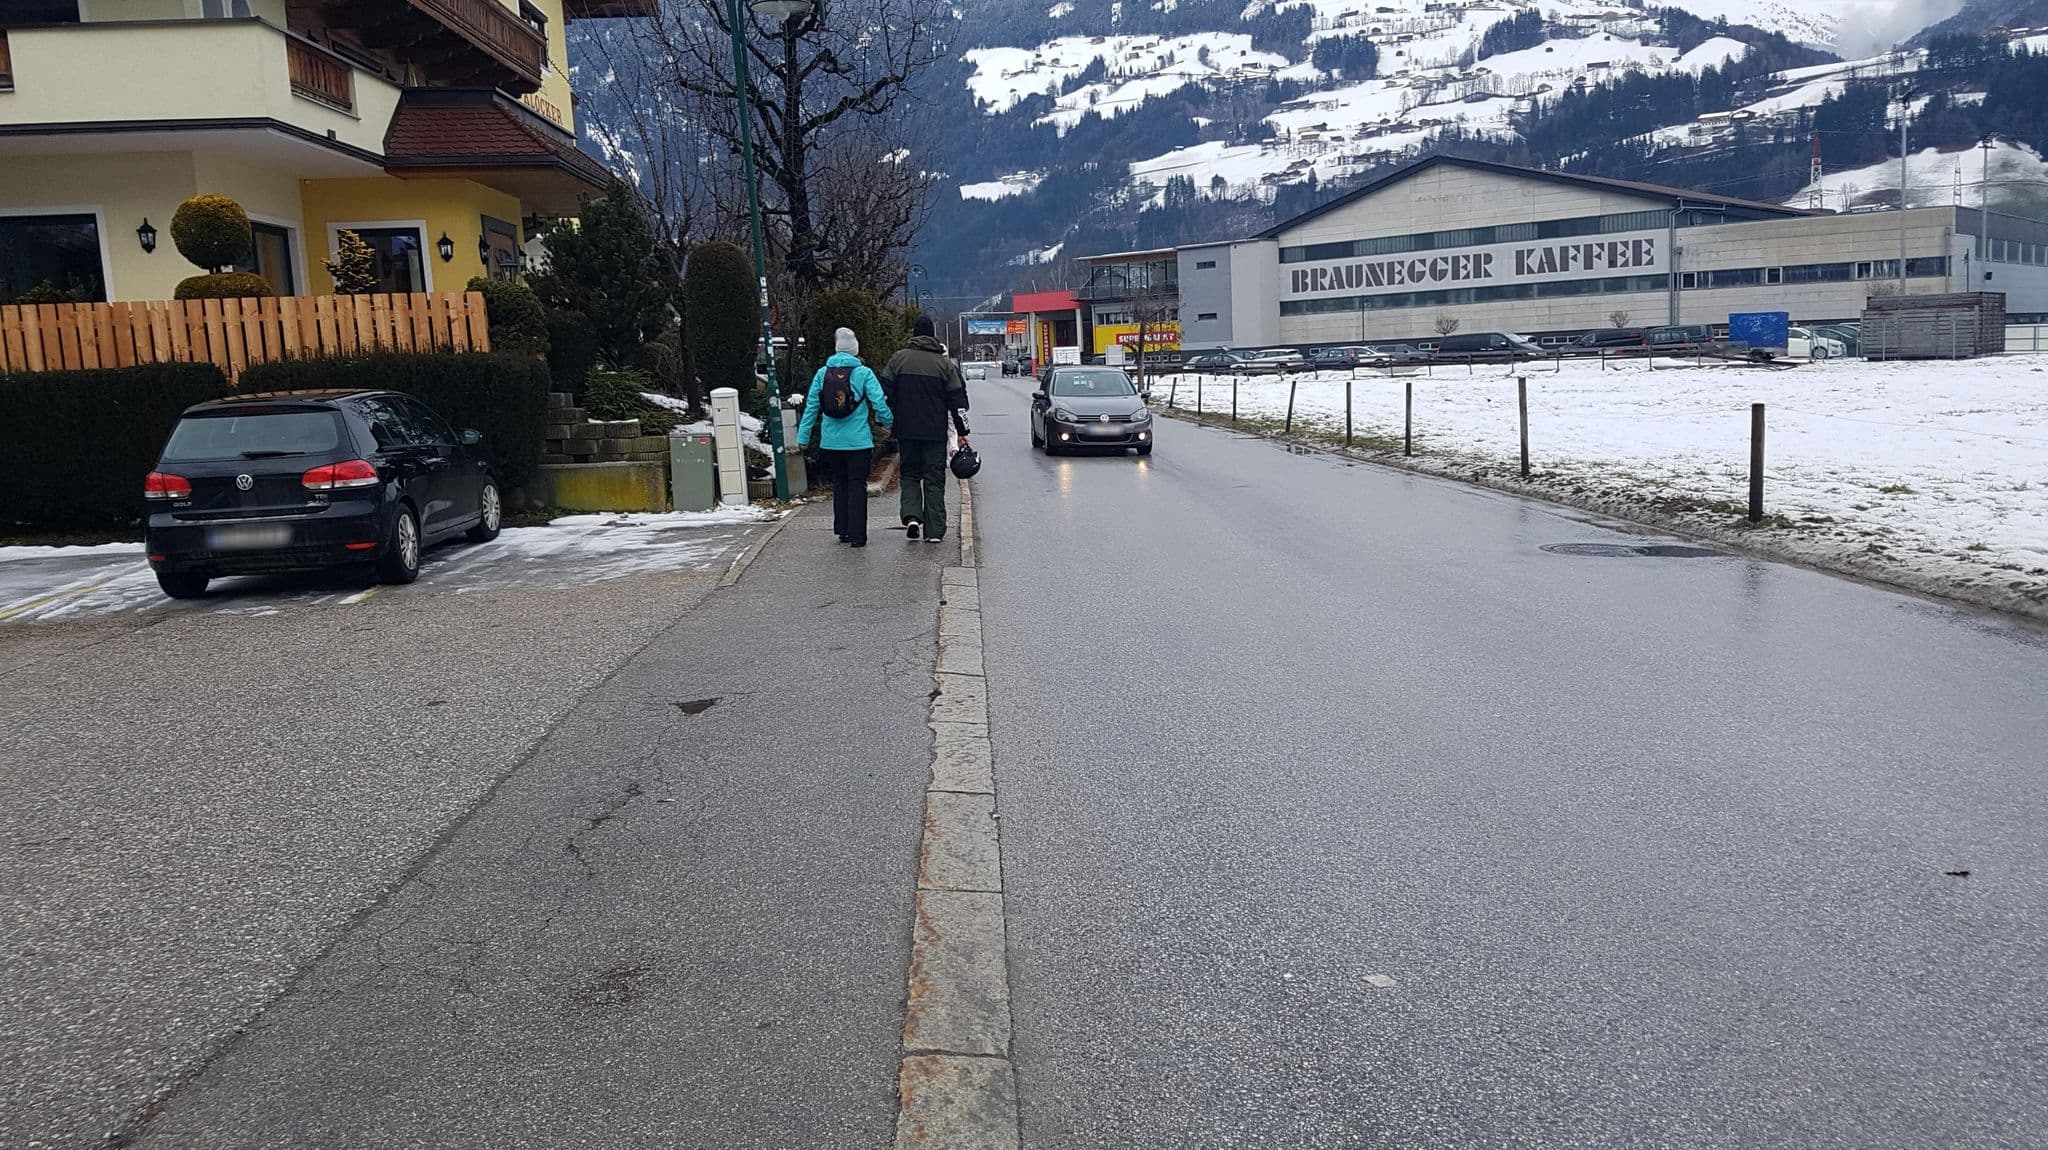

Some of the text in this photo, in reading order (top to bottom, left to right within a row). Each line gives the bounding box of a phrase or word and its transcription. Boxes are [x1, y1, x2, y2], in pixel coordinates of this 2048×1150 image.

[1291, 238, 1655, 293] BRAUNEGGER KAFFEE
[1118, 332, 1175, 344] SUPEMARKT
